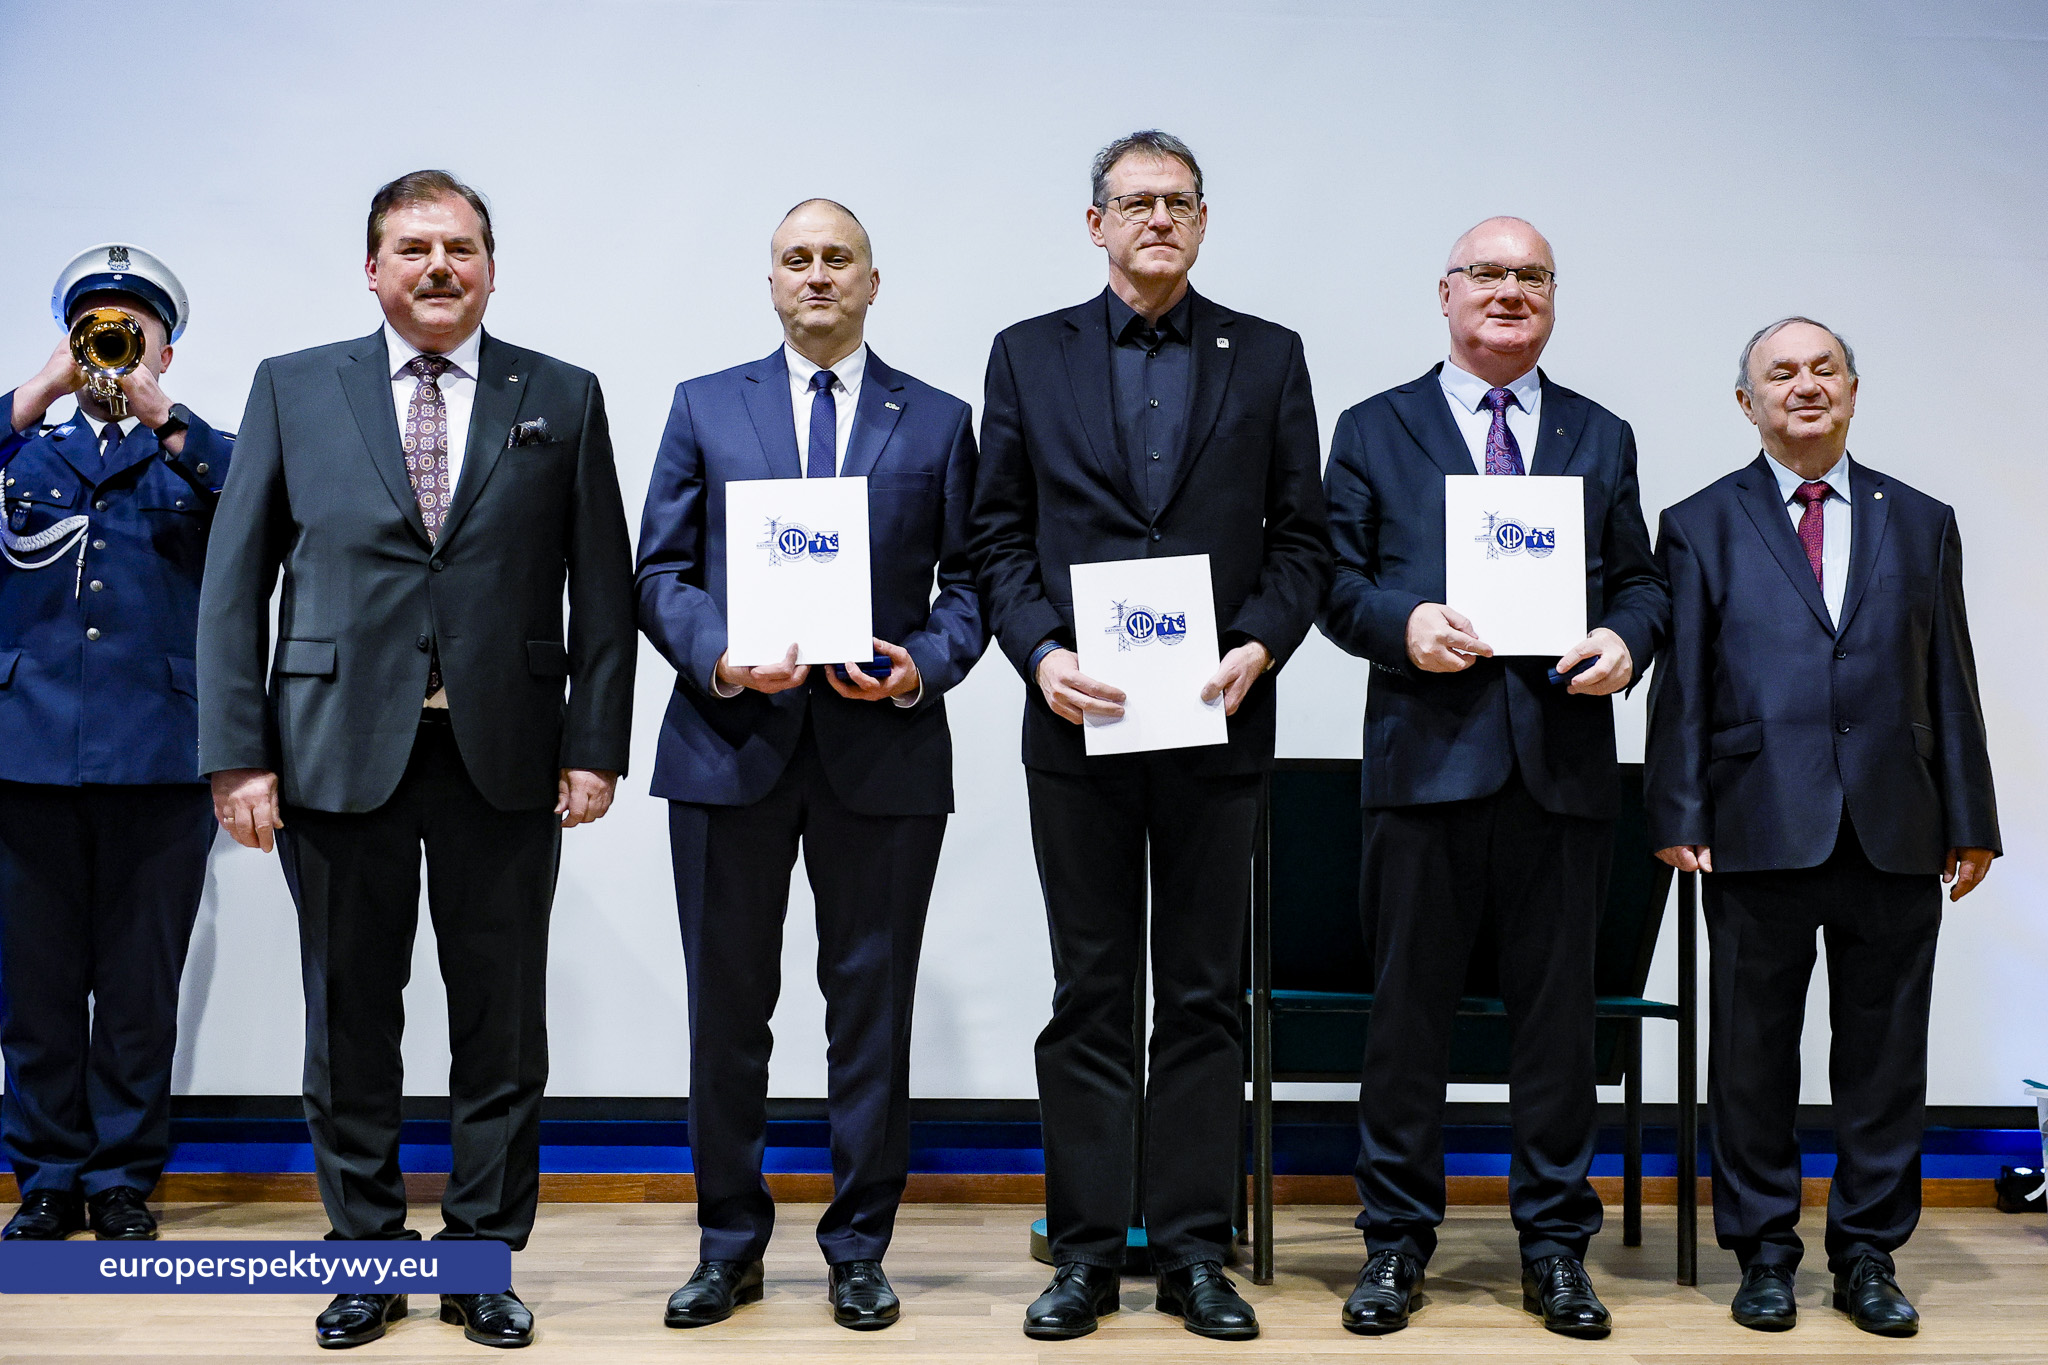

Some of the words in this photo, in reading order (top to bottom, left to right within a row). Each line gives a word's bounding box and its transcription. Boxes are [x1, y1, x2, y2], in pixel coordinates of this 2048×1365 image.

[781, 530, 806, 554] SEP
[1499, 525, 1522, 548] SEP
[1129, 613, 1152, 637] SEP
